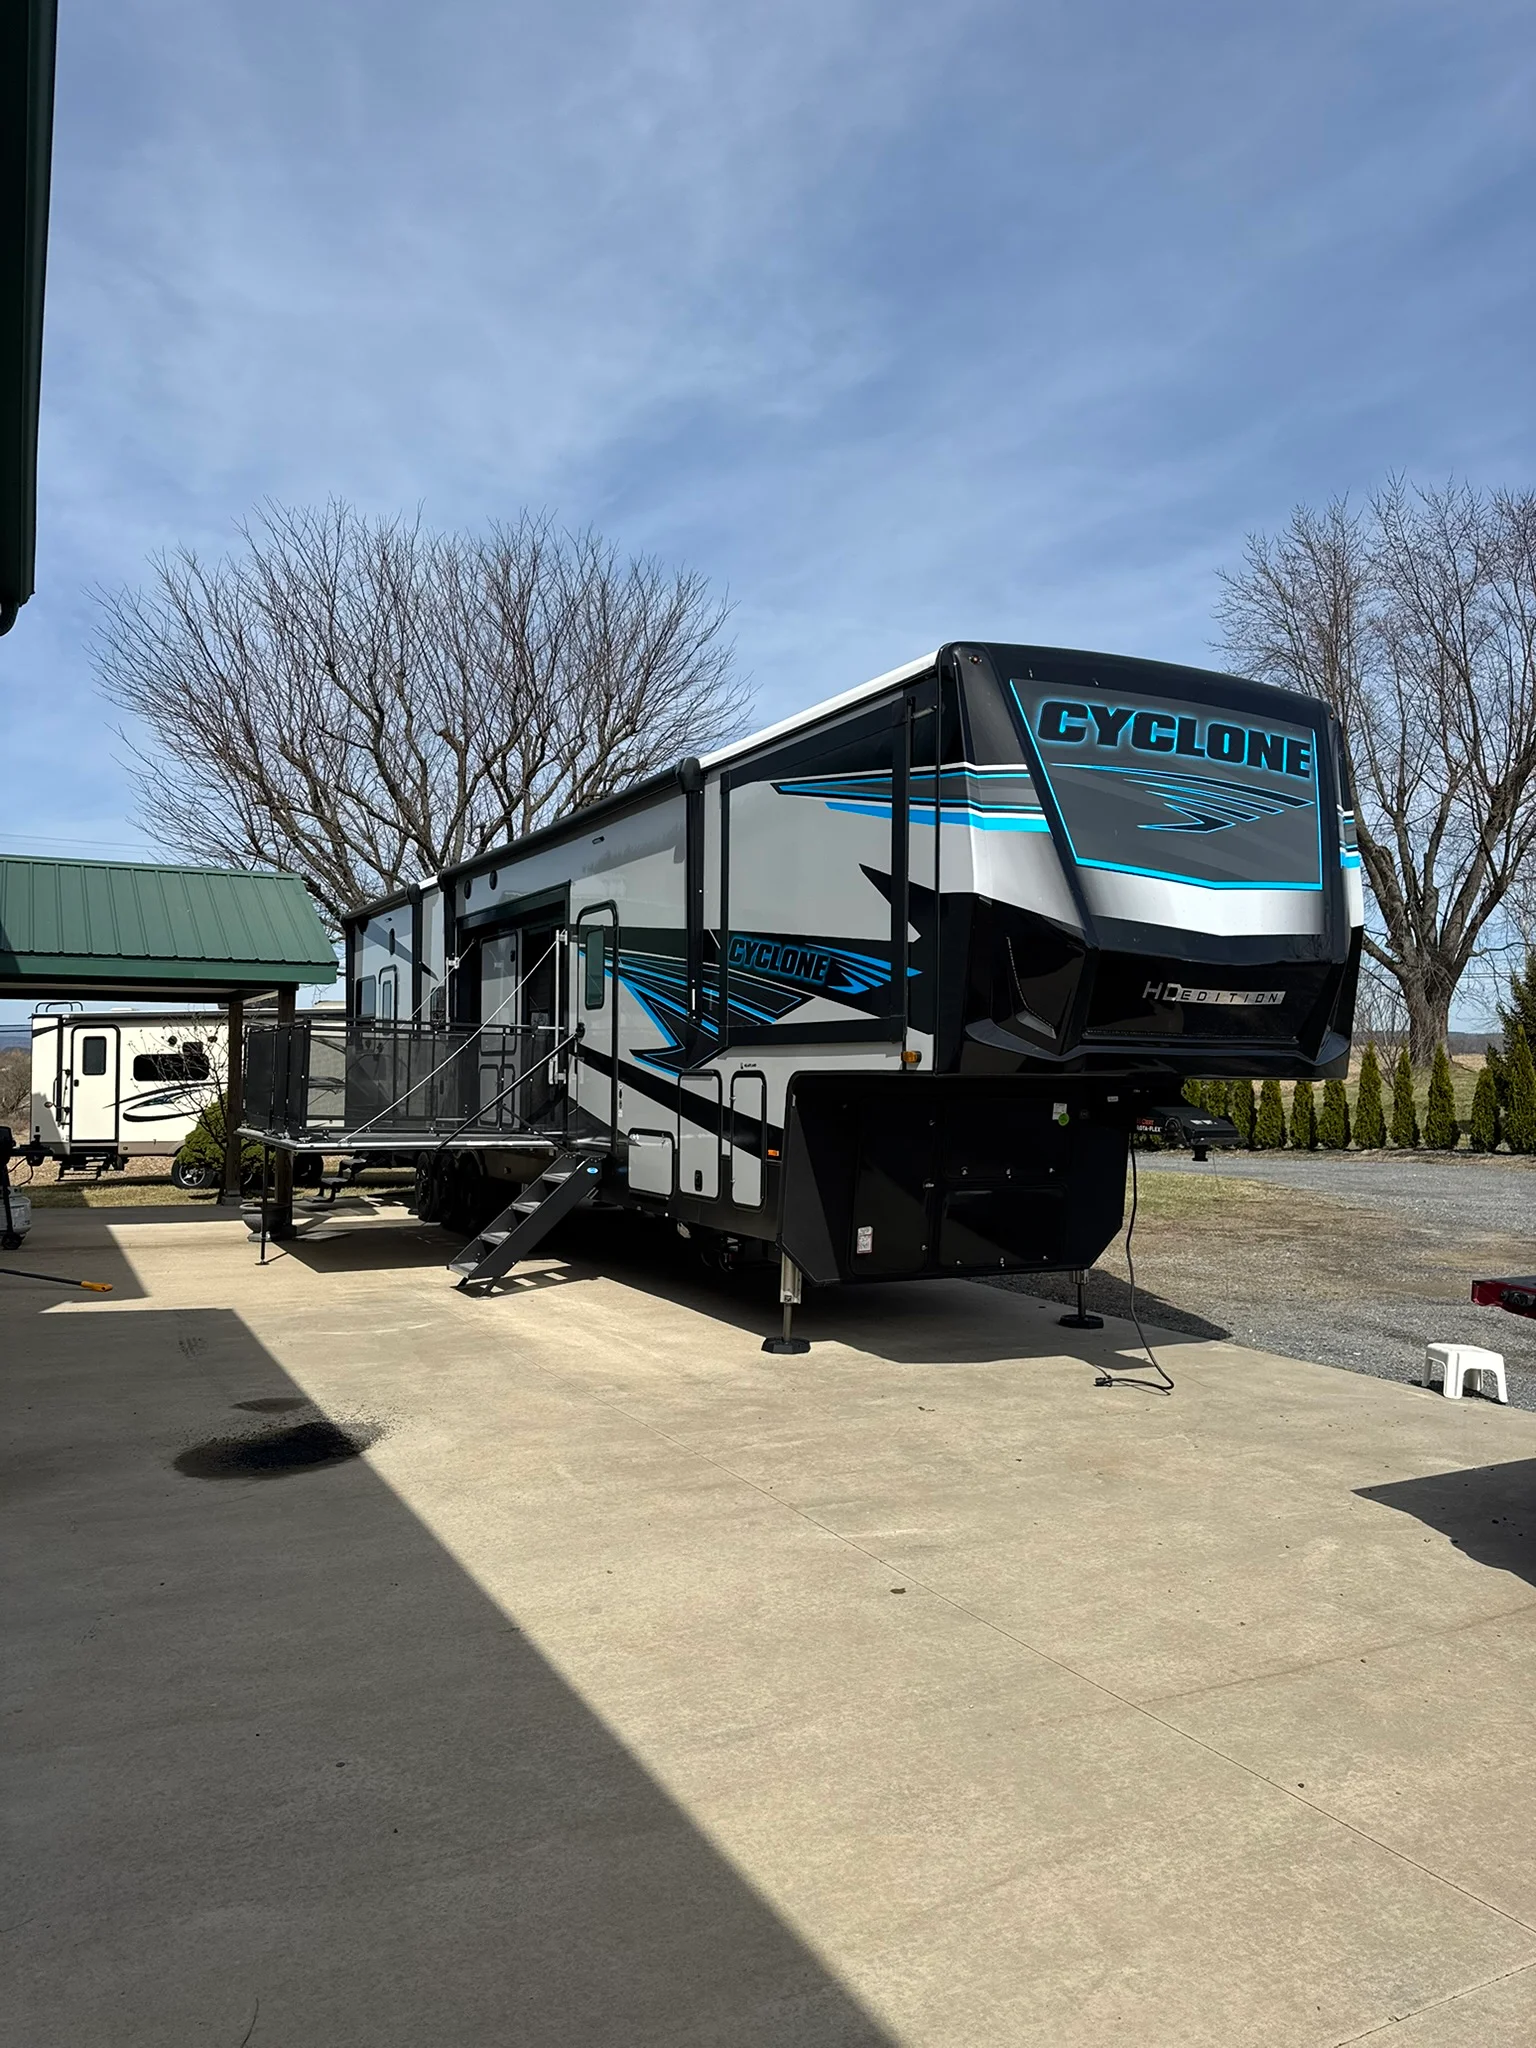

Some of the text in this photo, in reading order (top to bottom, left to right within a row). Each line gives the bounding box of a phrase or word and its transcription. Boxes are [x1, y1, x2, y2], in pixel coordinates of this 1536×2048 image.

[1037, 699, 1311, 779] CYCLONE
[728, 937, 829, 983] CYCLONE
[1142, 981, 1278, 1004] HD EDITION
